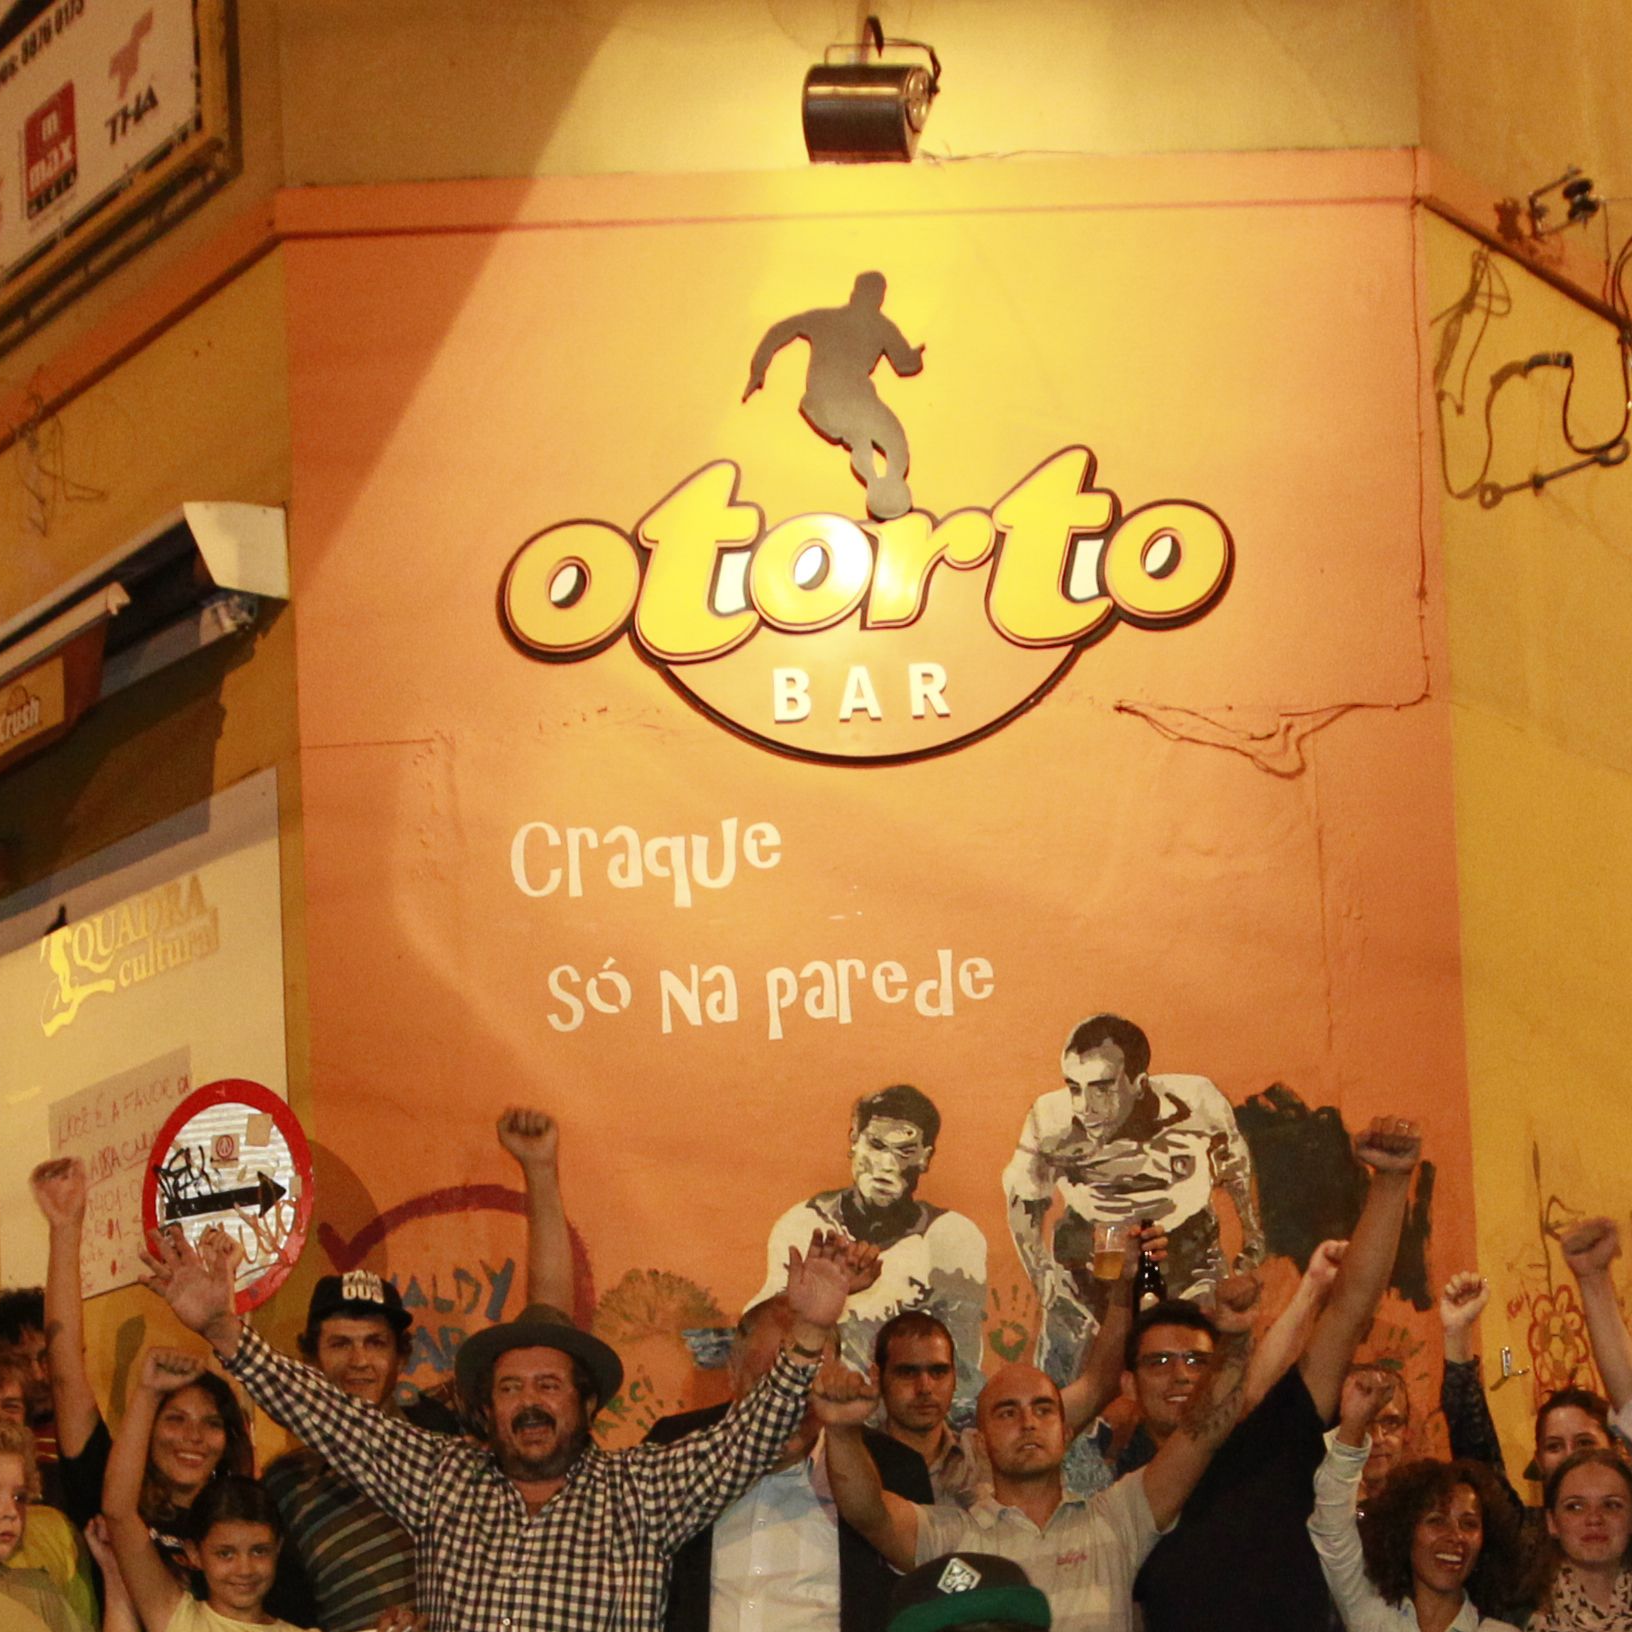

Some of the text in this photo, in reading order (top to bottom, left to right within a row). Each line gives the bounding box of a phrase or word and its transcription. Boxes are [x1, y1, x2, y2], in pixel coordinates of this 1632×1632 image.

[773, 661, 952, 722] BAR
[510, 816, 782, 907] Craque
[71, 873, 206, 974] QUADRA
[119, 905, 219, 987] cultural
[547, 947, 996, 1039] Só Na parede
